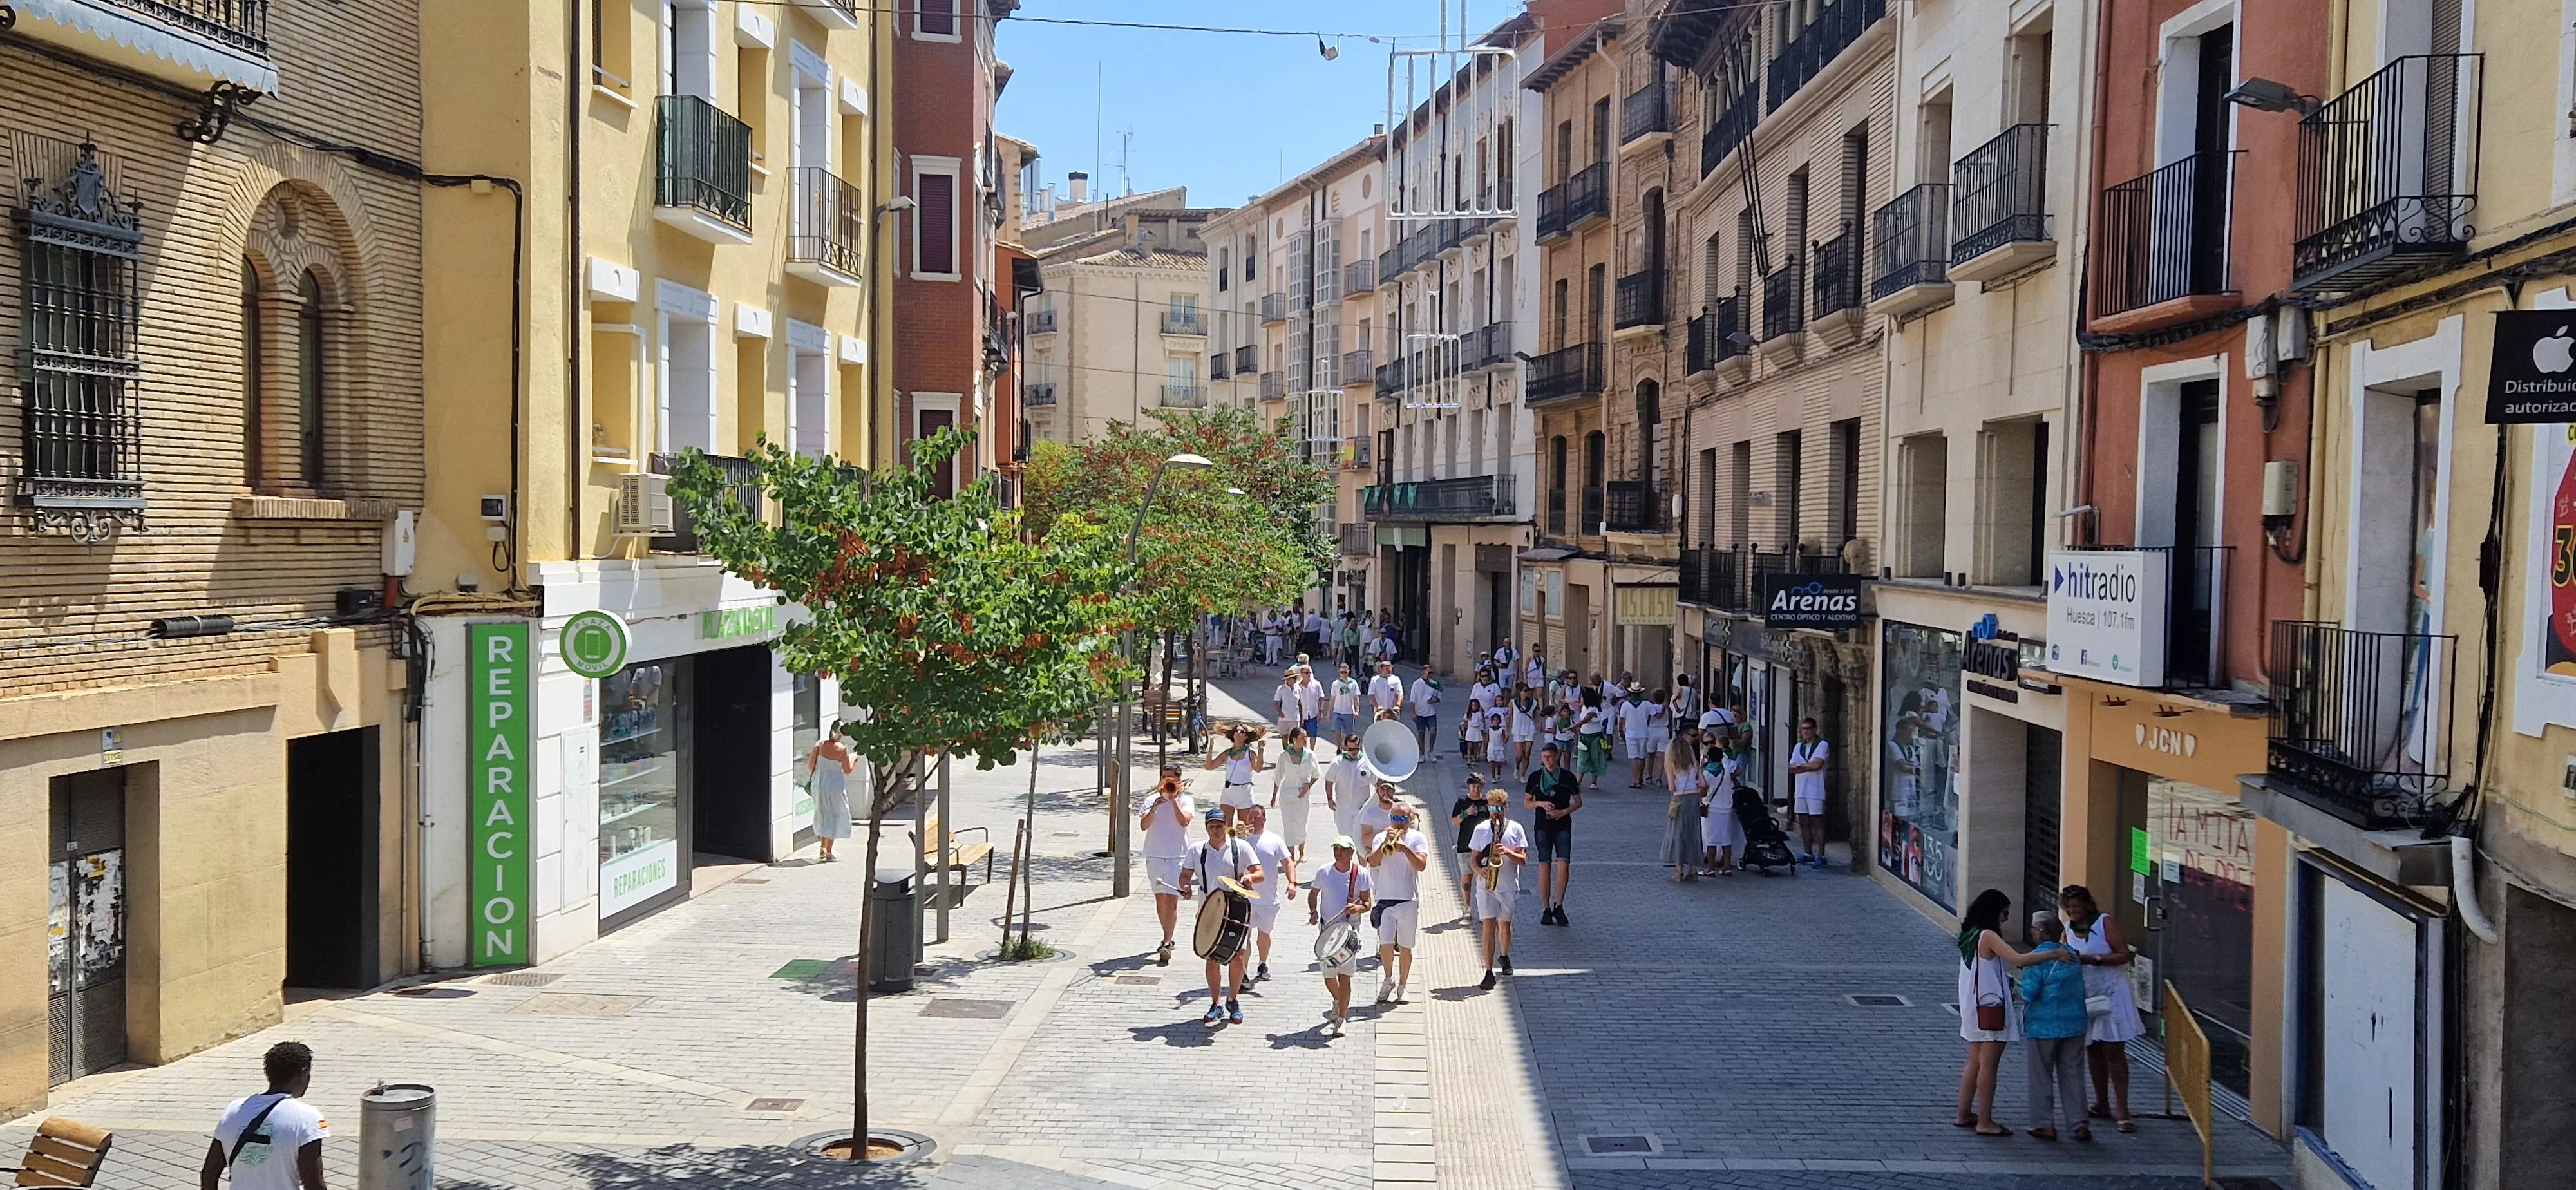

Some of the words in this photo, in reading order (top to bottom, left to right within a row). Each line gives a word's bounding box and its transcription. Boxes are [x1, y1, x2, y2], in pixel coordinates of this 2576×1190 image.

[2553, 525, 2576, 587] 3
[2068, 562, 2136, 603] hitradio
[1771, 590, 1857, 611] Arenas
[574, 618, 611, 631] PLAZA
[1797, 612, 1820, 621] ÓPTICO
[2067, 607, 2095, 625] Huesca
[2103, 610, 2135, 630] 107.1fm
[576, 659, 609, 670] MOVIL
[1962, 631, 2018, 681] Arenas
[2148, 726, 2182, 756] JCN
[484, 636, 515, 957] REPARACION
[614, 858, 666, 898] REPARACIONES
